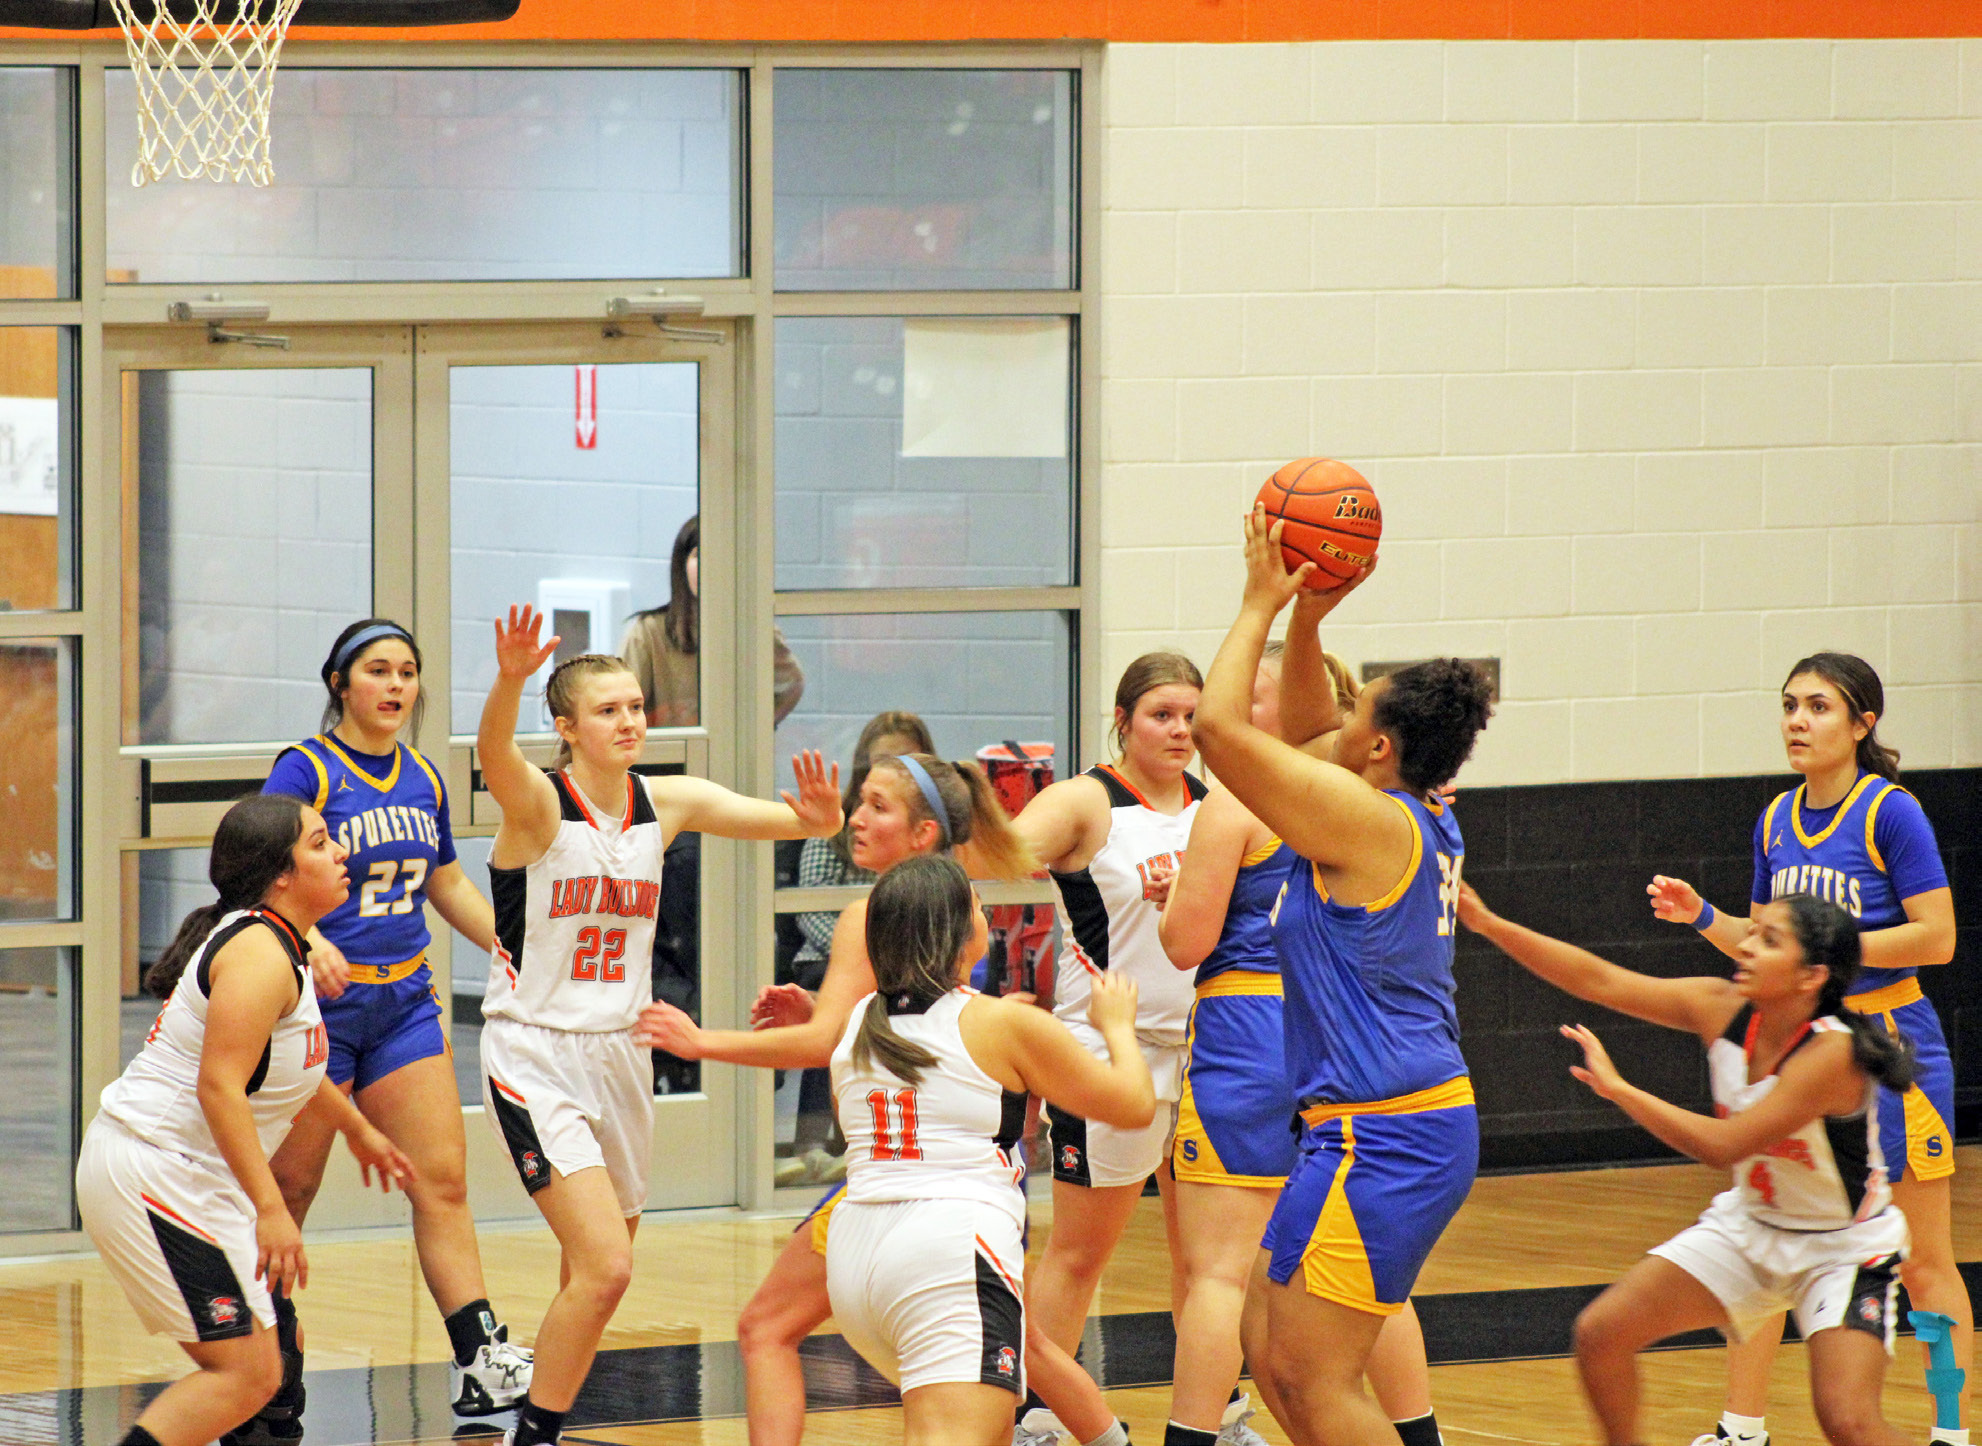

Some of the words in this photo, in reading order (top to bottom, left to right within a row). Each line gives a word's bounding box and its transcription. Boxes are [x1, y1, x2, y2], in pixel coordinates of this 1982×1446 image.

[359, 858, 428, 917] 23
[549, 876, 598, 919] LADY
[571, 926, 627, 983] 22
[866, 1087, 924, 1161] 11
[1925, 1135, 1943, 1158] S
[1183, 1139, 1199, 1161] S
